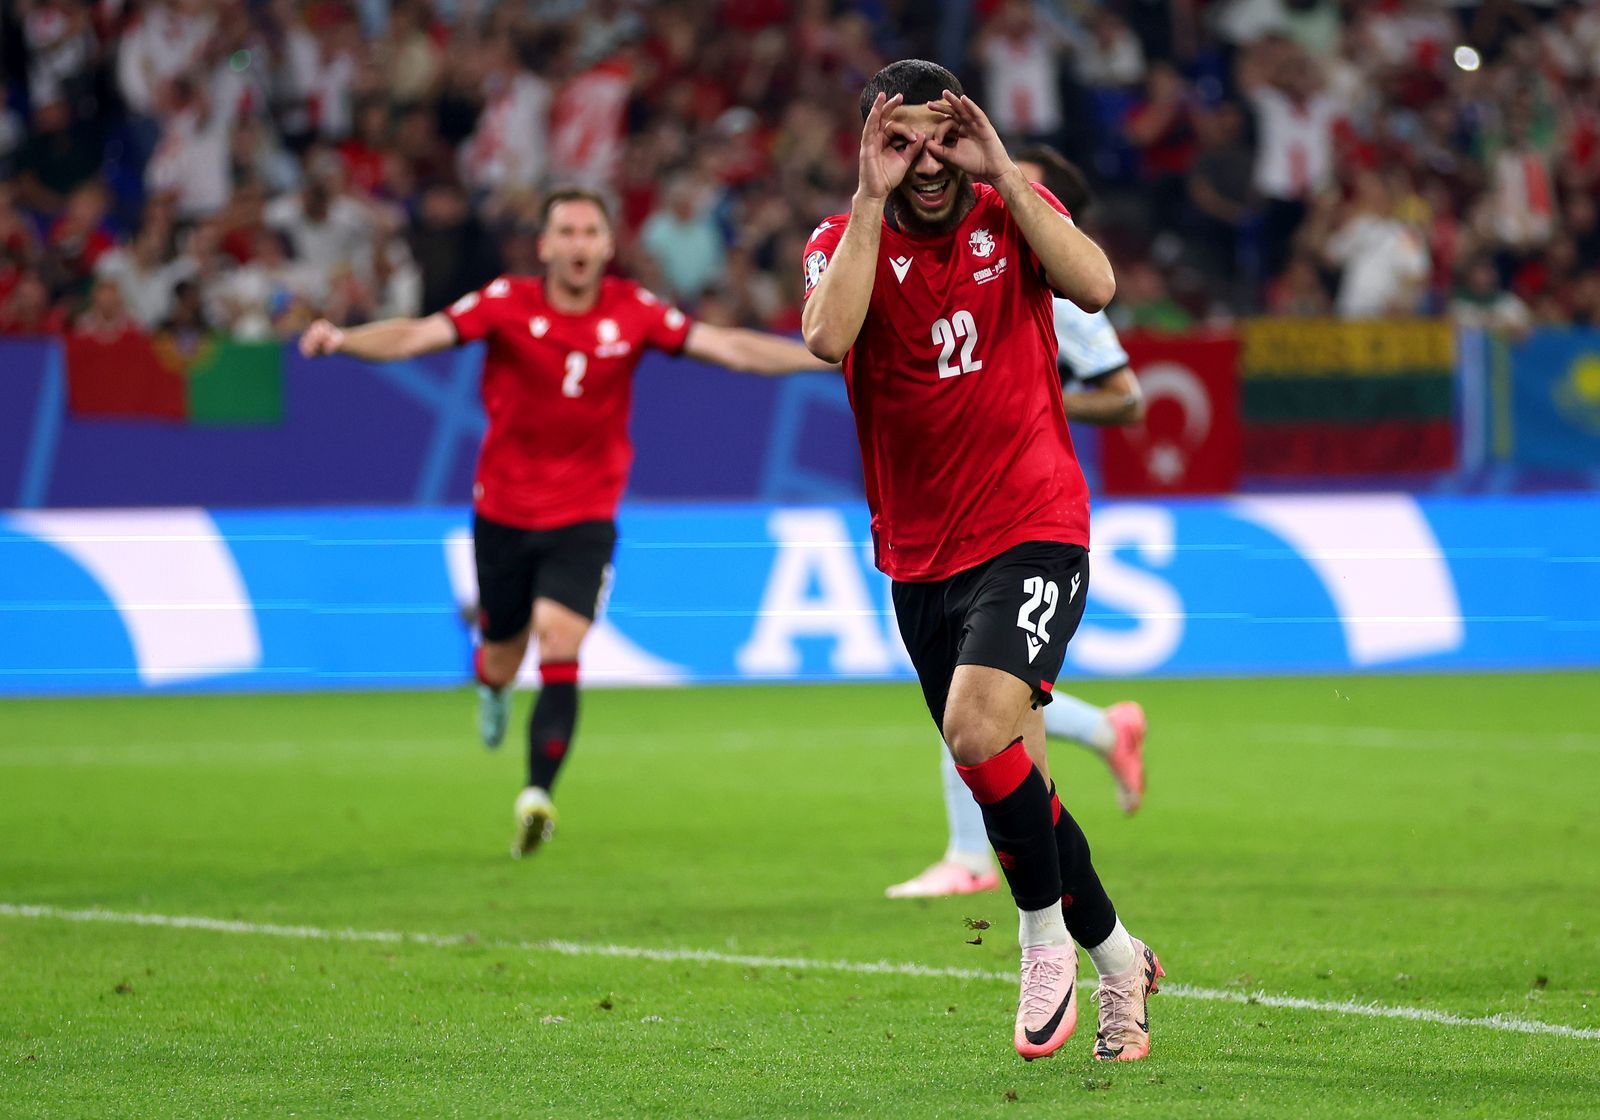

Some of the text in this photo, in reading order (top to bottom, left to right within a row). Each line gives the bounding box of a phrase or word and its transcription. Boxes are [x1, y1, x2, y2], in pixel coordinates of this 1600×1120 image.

[562, 351, 588, 398] 2
[931, 310, 983, 379] 22
[1016, 576, 1059, 644] 22
